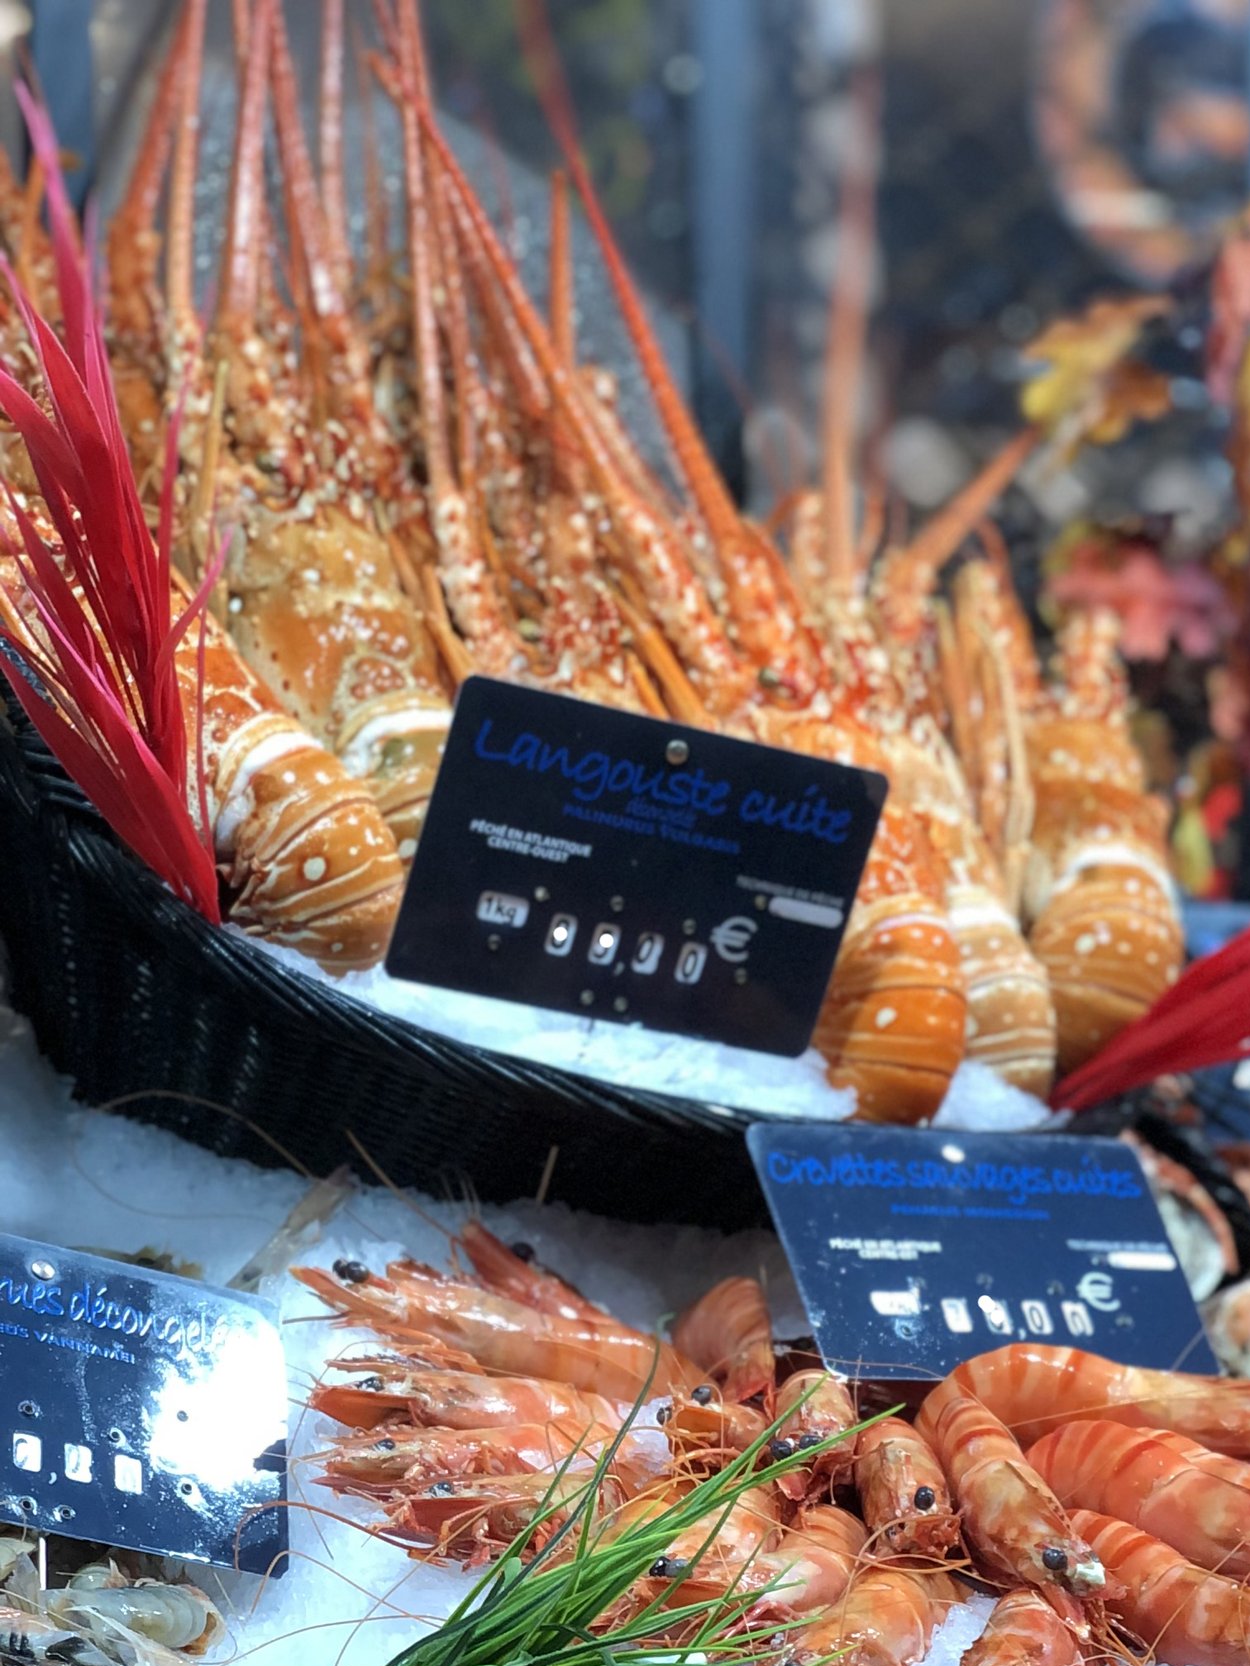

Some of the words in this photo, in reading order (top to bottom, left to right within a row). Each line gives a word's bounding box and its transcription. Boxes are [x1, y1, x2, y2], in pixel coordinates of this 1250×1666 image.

[474, 717, 733, 817] Langouste
[738, 783, 852, 844] cuite
[469, 818, 507, 838] PÊCHÉ
[507, 826, 525, 842] EN
[523, 831, 594, 858] ATLANTIQUE
